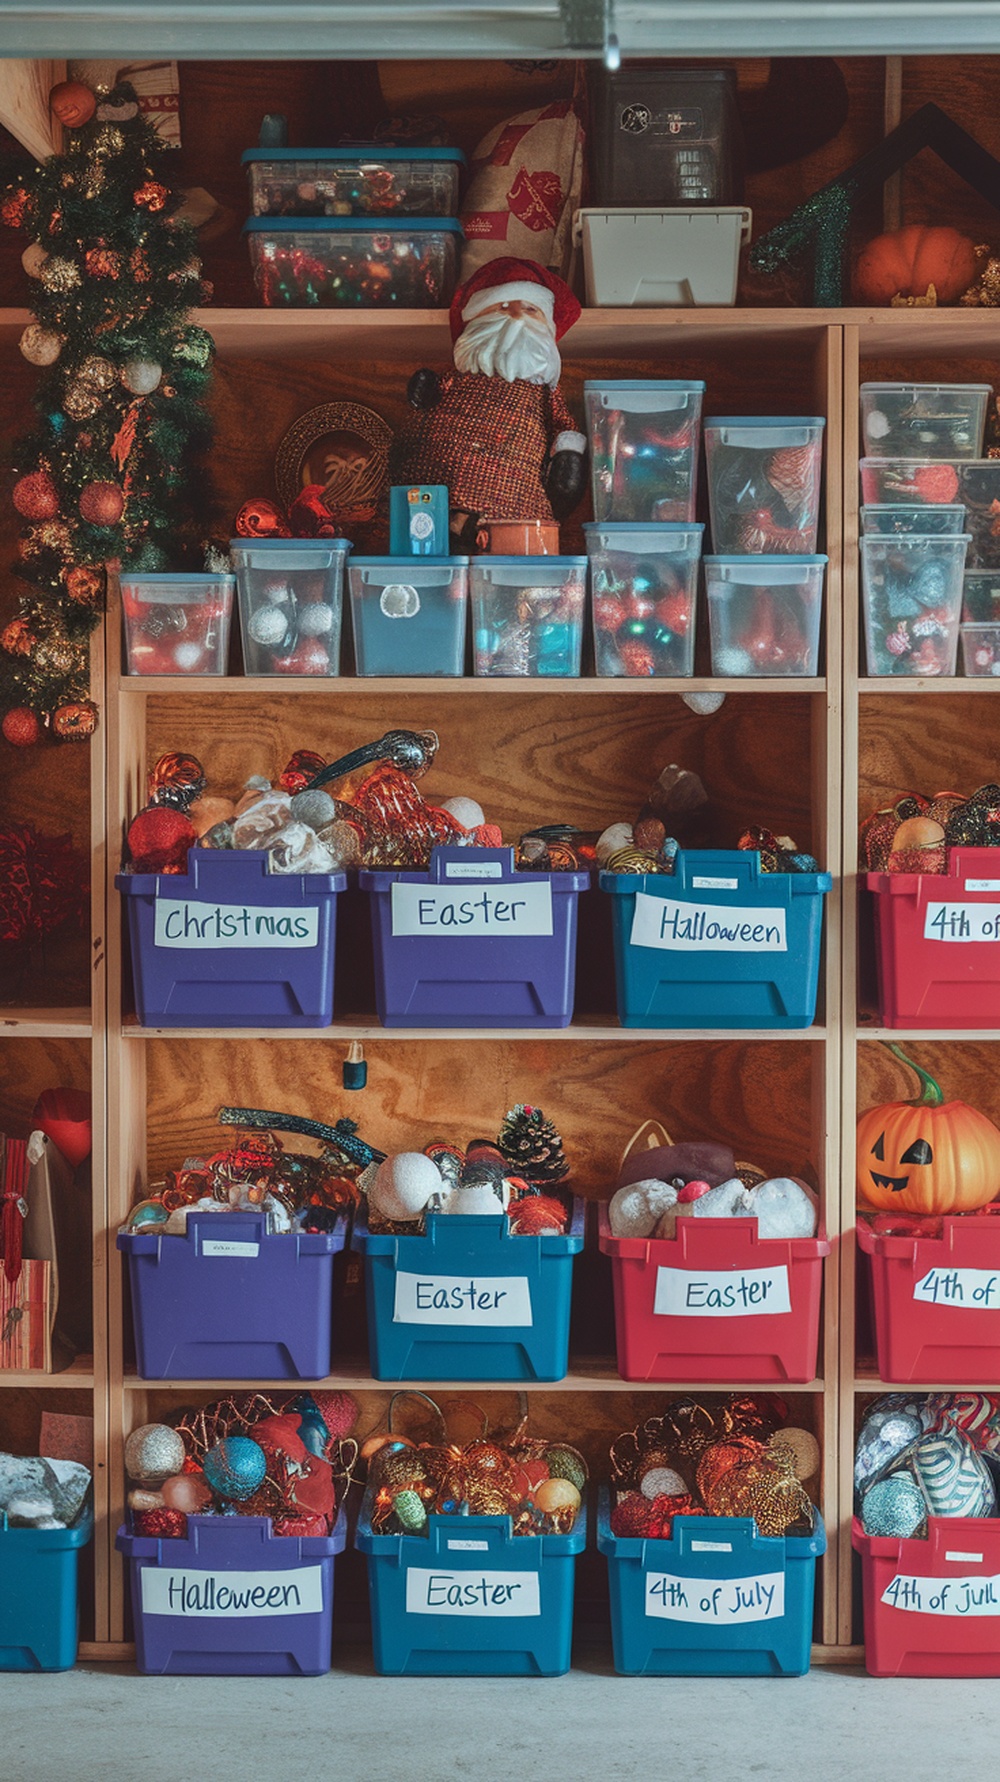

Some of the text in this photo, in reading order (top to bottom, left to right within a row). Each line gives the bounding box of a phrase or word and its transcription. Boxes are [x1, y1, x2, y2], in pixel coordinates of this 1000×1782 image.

[418, 890, 527, 926] Easter
[416, 1280, 508, 1311] Easter
[685, 1276, 774, 1308] Easter
[922, 1270, 998, 1305] 4th of
[426, 1575, 522, 1608] Easter
[649, 1577, 689, 1608] 4th
[699, 1587, 723, 1616] of
[886, 1577, 922, 1610] 4th
[929, 1584, 952, 1611] of
